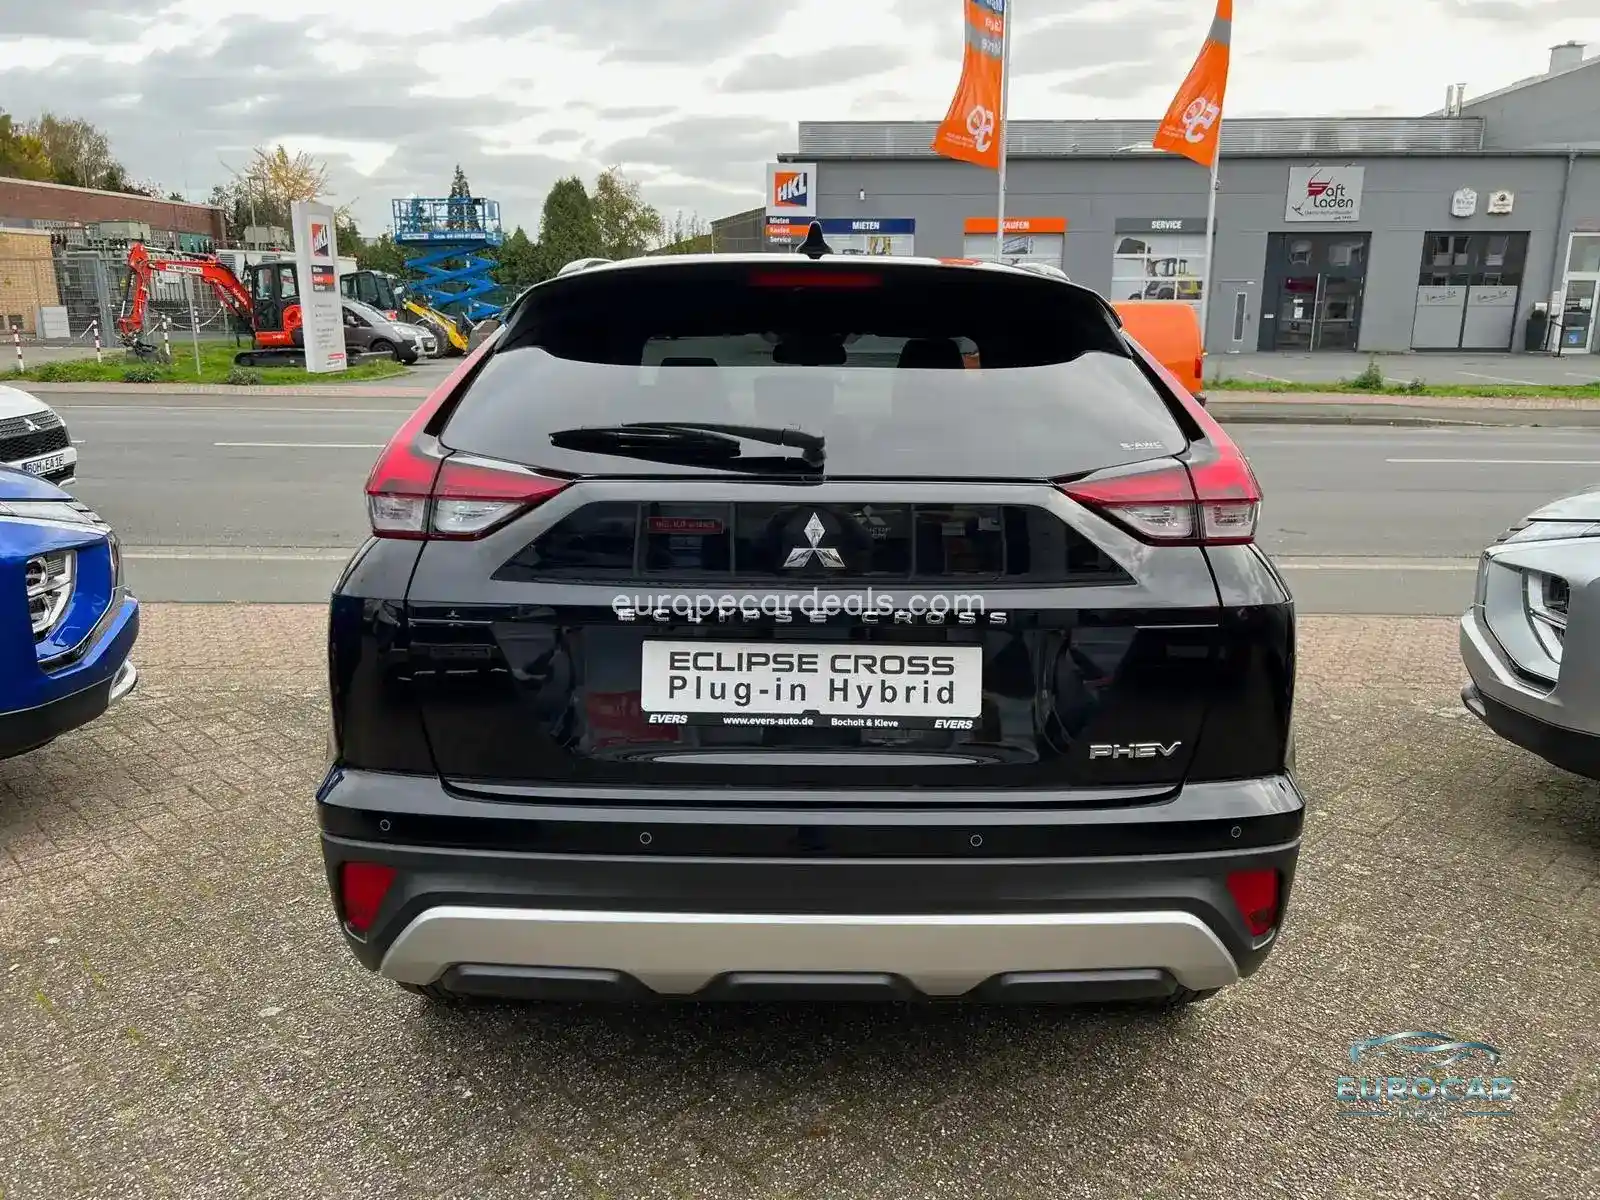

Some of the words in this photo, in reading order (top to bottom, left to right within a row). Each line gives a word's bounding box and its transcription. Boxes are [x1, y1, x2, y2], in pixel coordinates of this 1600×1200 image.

[777, 172, 806, 202] HKL
[852, 221, 881, 230] MIETEN
[1151, 220, 1183, 229] SERVICE
[617, 608, 827, 624] ECLIPSE
[861, 611, 1008, 625] CROSS
[669, 651, 819, 673] ECLIPSE
[830, 654, 955, 676] CROSS
[669, 675, 806, 706] Plug-in
[829, 678, 954, 709] Hybrid
[648, 714, 689, 724] EVERS
[723, 716, 814, 726] www.evers-auto.de
[831, 718, 865, 727] Bocholt
[866, 718, 873, 727] &
[874, 718, 899, 728] Kleve
[934, 719, 974, 729] EVERS
[1089, 741, 1182, 759] PHEV
